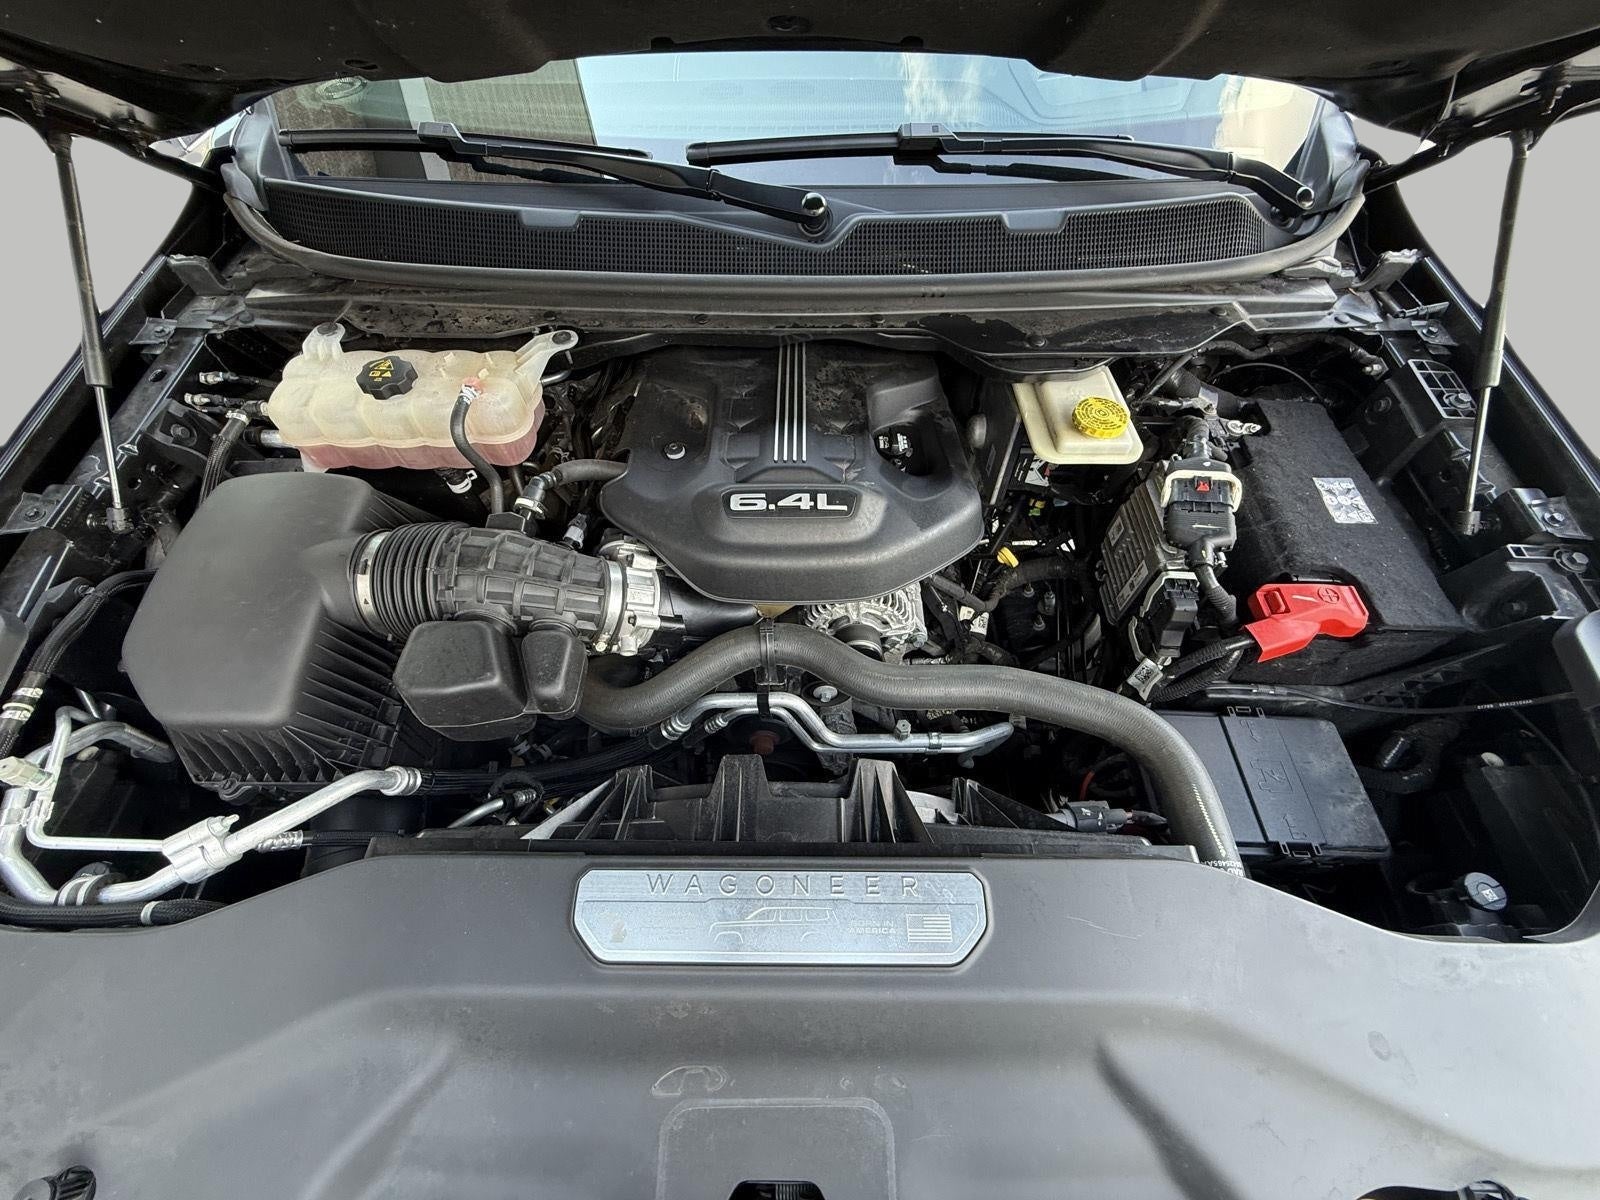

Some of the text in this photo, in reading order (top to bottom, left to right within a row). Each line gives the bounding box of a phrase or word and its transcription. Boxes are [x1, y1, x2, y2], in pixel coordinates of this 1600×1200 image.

[730, 493, 847, 511] 6.4L
[646, 873, 919, 897] WAGONEER
[883, 919, 894, 928] IN
[848, 927, 897, 935] AMERICA
